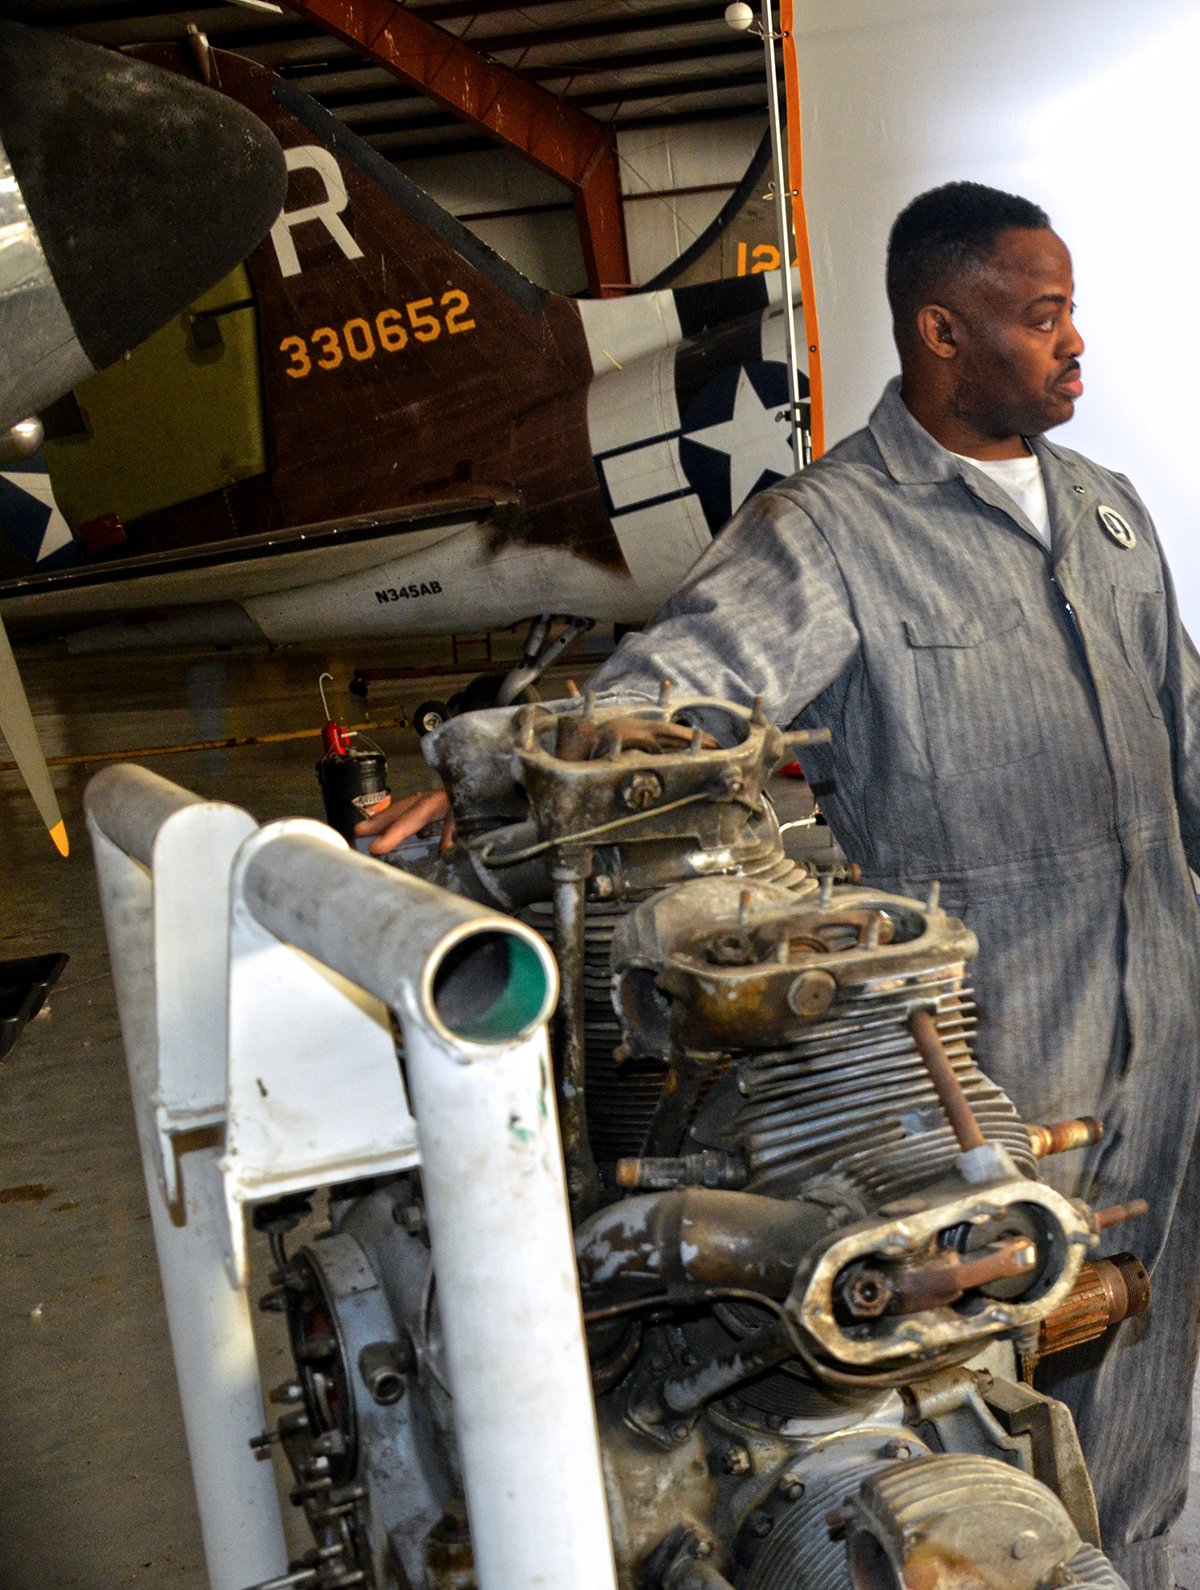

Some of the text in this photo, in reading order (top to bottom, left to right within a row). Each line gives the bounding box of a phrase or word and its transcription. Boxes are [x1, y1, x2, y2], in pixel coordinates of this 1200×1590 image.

[270, 145, 365, 278] R
[279, 288, 477, 379] 330652
[374, 580, 443, 604] N345AB
